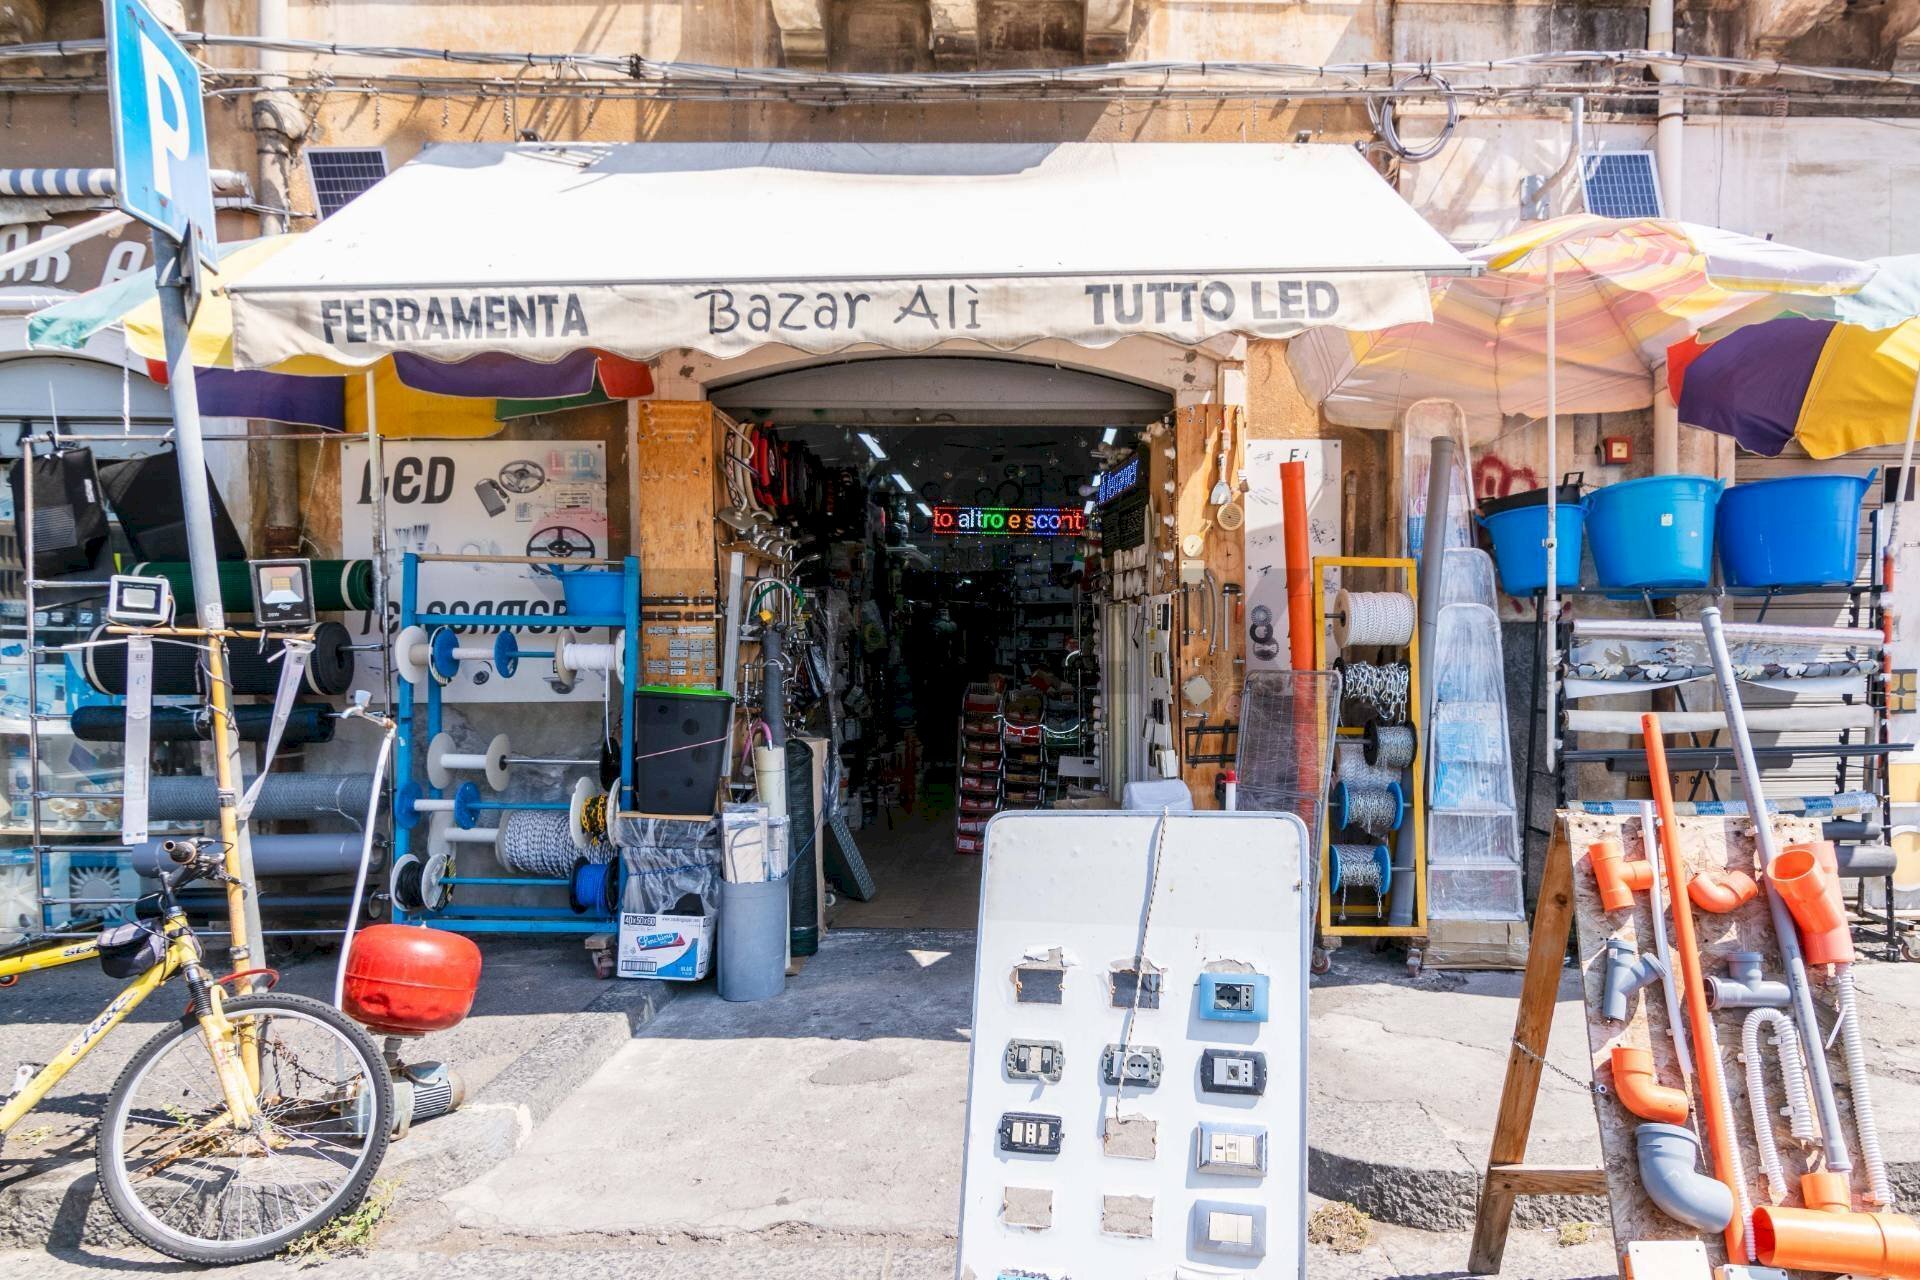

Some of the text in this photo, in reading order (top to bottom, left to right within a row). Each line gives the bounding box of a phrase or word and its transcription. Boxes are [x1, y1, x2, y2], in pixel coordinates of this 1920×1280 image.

[140, 30, 190, 199] P
[321, 280, 1339, 344] FERRAMENTA Bazar Alì TUTTO LED
[958, 509, 1004, 529] altro
[1008, 513, 1021, 529] e
